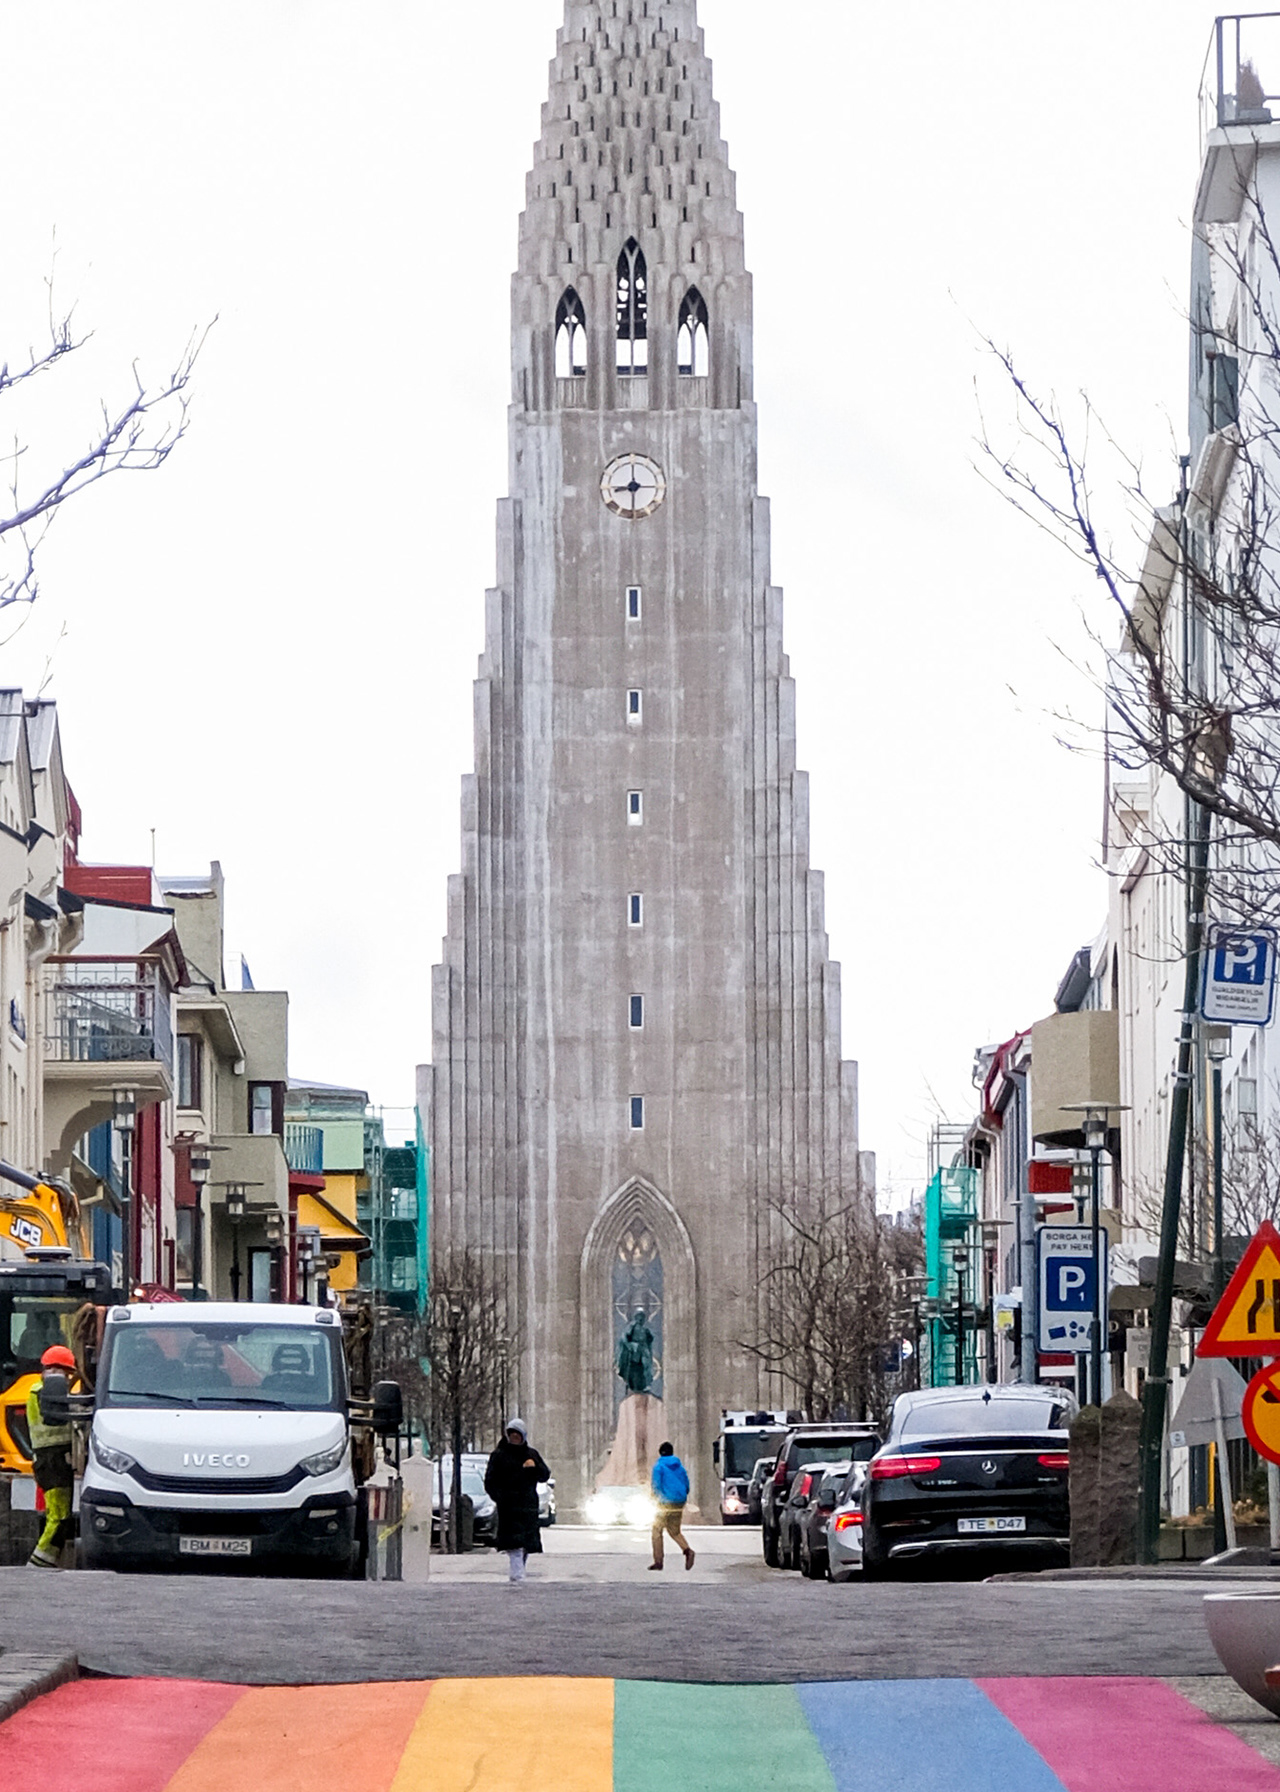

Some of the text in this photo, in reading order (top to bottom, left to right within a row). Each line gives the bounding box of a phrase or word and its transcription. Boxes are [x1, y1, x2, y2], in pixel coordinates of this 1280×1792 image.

[10, 1218, 42, 1247] JCB
[183, 1453, 250, 1468] IVECO
[969, 1518, 1023, 1530] TE D47
[190, 1539, 249, 1553] BM M25
